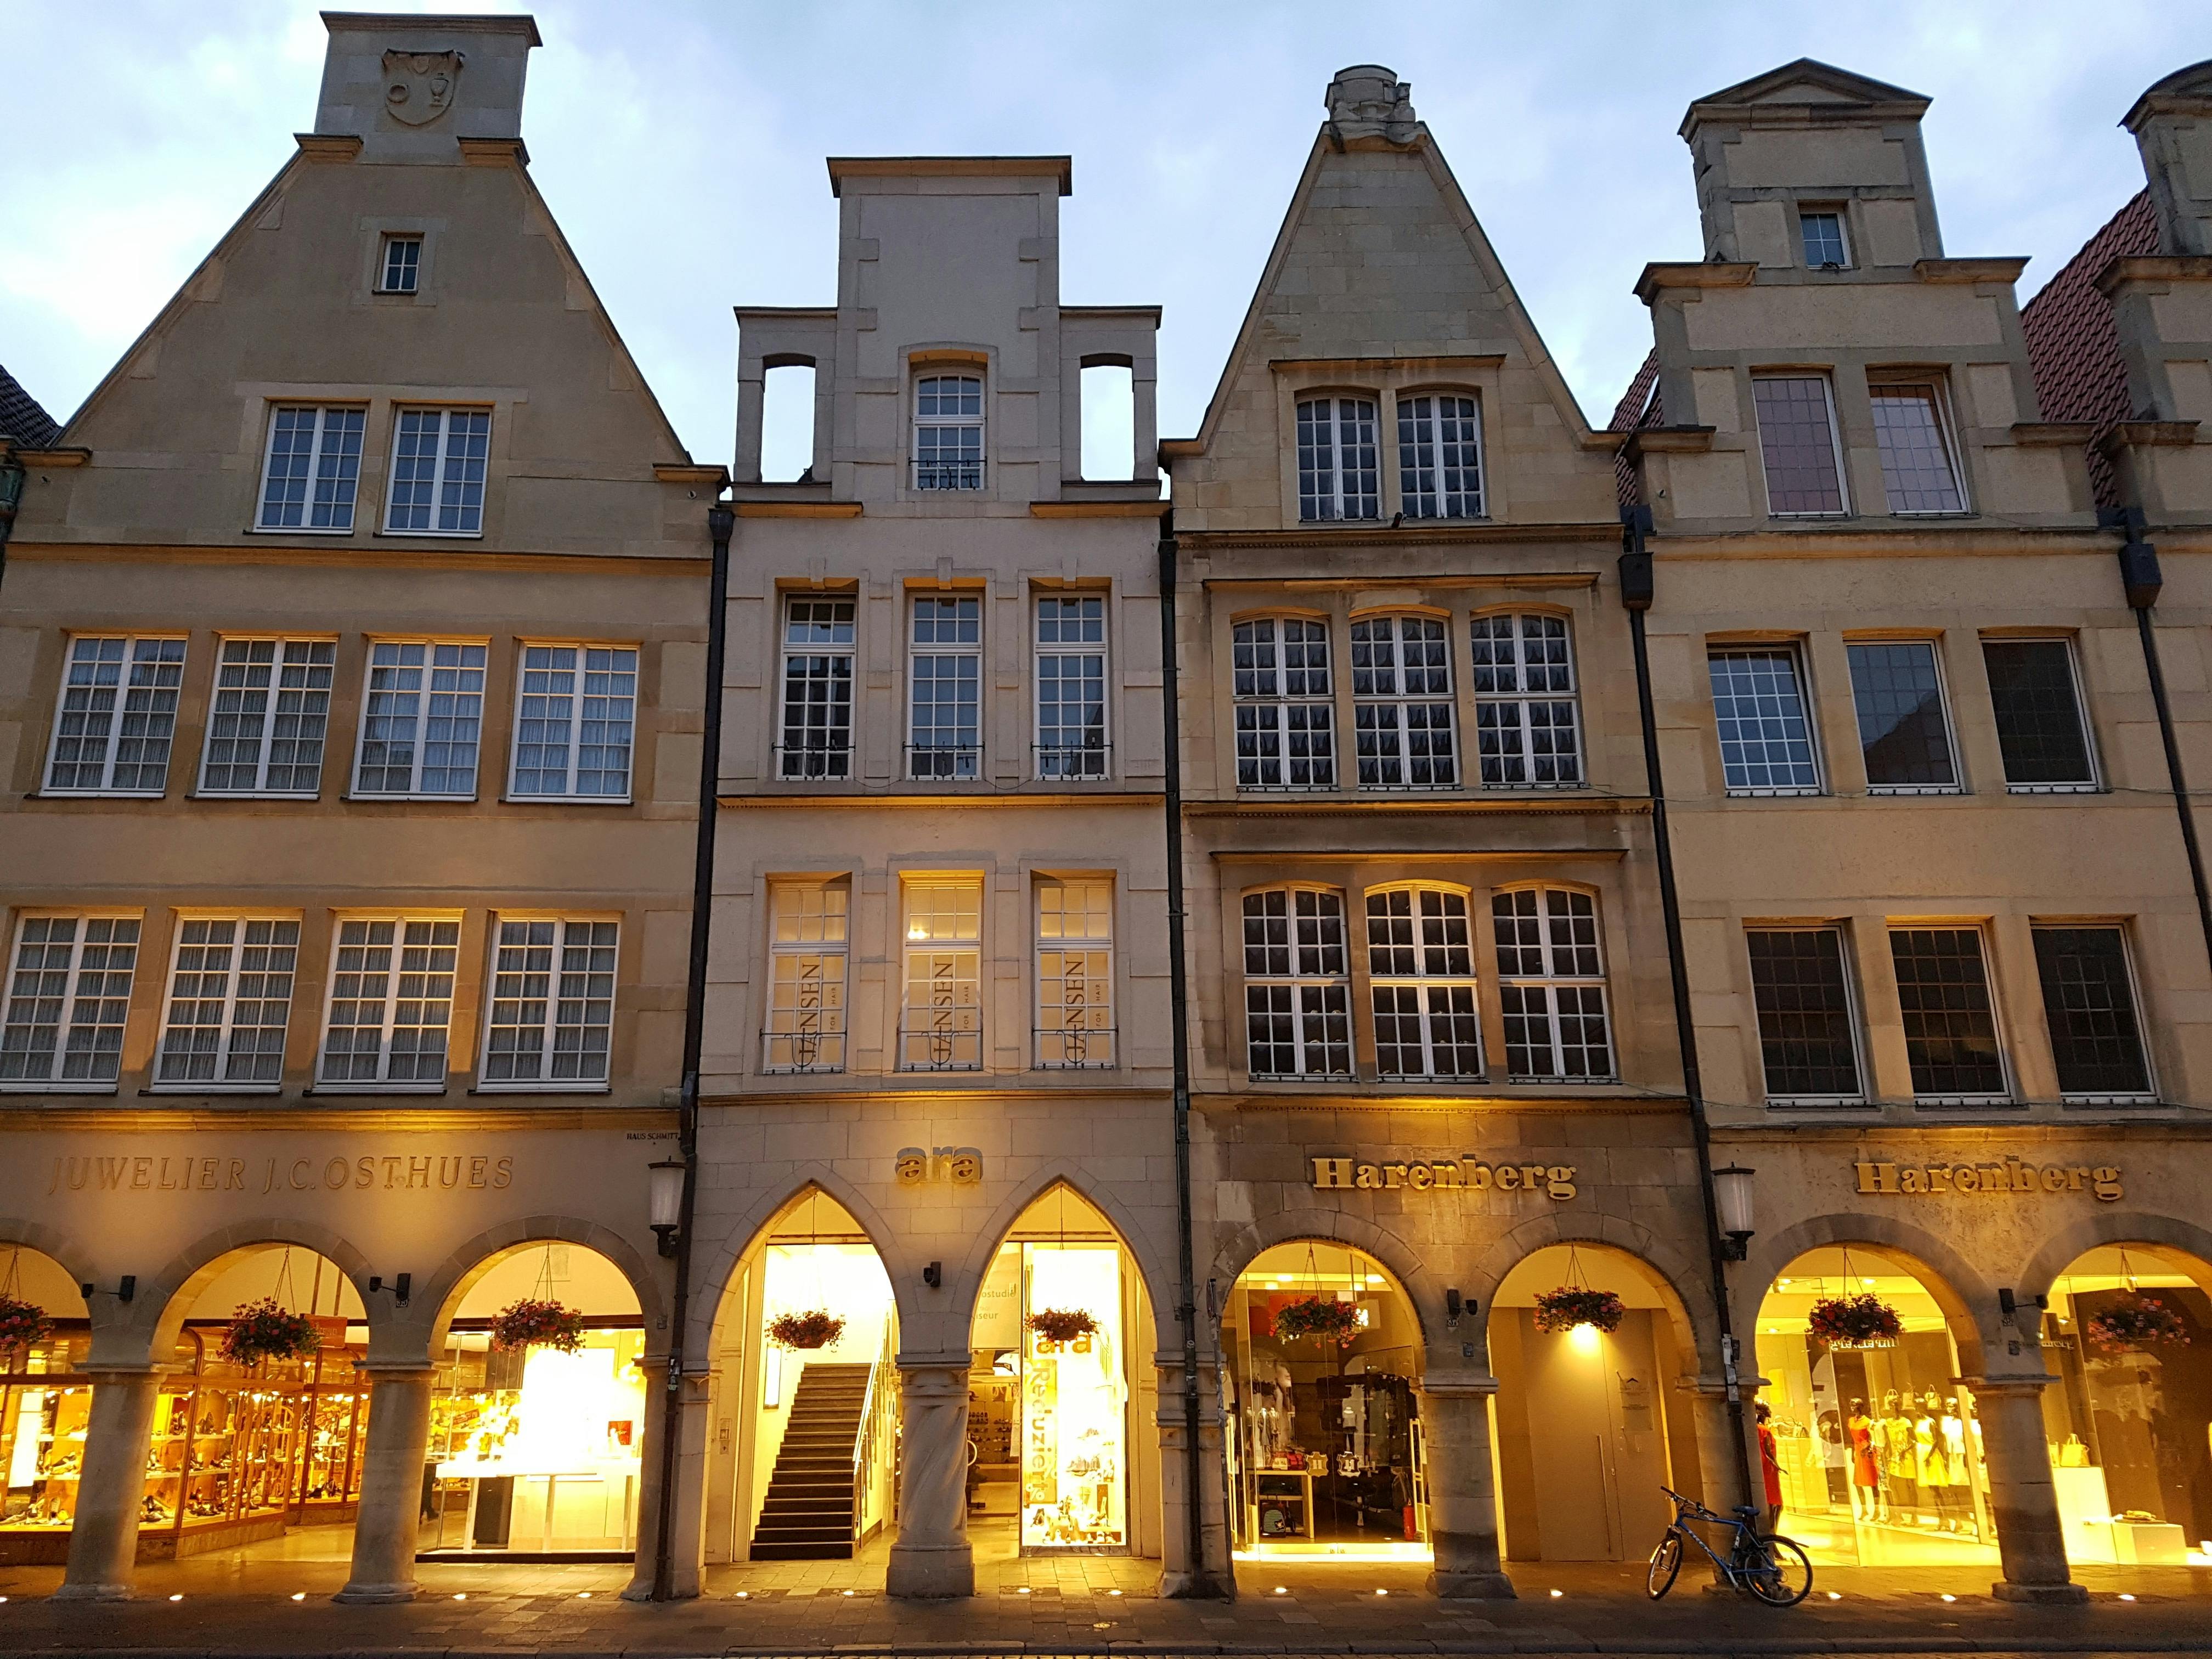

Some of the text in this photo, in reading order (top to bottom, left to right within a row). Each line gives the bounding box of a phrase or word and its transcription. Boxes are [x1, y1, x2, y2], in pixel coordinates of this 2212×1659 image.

[799, 963, 820, 1057] JANSEN
[934, 961, 953, 1056] JANSEN
[1066, 960, 1085, 1054] JANSEN
[48, 1156, 246, 1195] JUWELIER
[896, 1149, 982, 1184] ara
[1311, 1156, 1577, 1201] Harenberg
[1854, 1159, 2125, 1201] Harenberg
[1032, 1368, 1052, 1491] Reduziert
